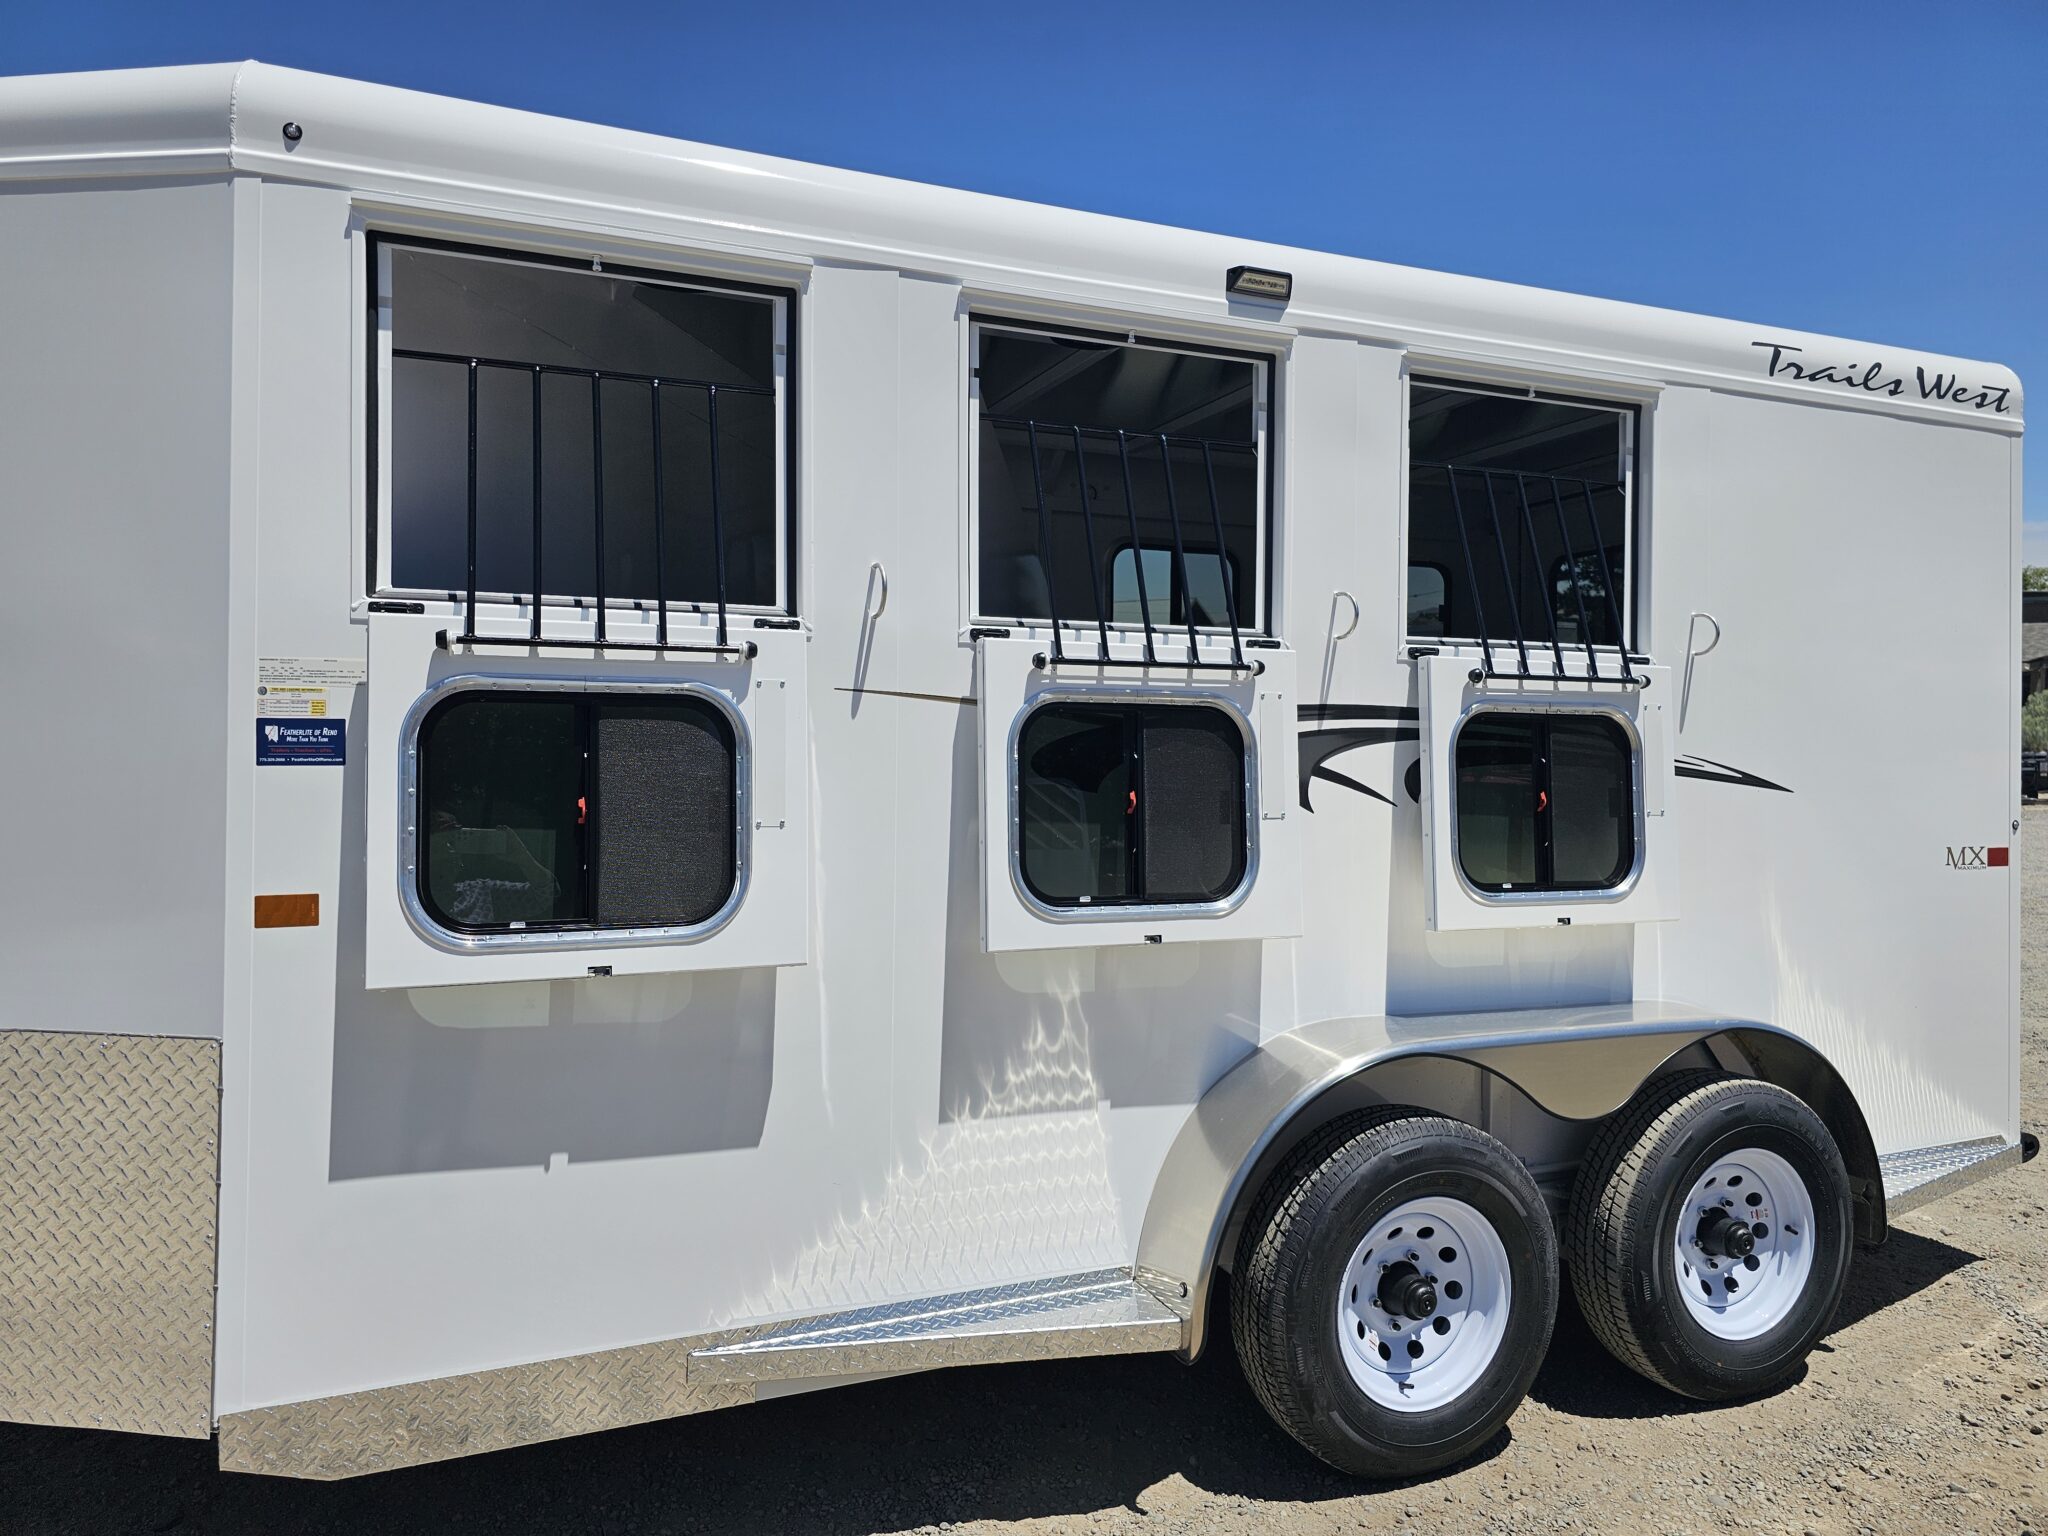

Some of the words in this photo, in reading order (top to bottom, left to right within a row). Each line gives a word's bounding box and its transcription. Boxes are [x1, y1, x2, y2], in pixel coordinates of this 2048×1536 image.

[1751, 341, 1904, 396] Trails
[1916, 366, 2011, 413] West
[280, 727, 313, 736] FEATHERLITE
[322, 727, 338, 736] RENO
[1945, 846, 1986, 870] MX
